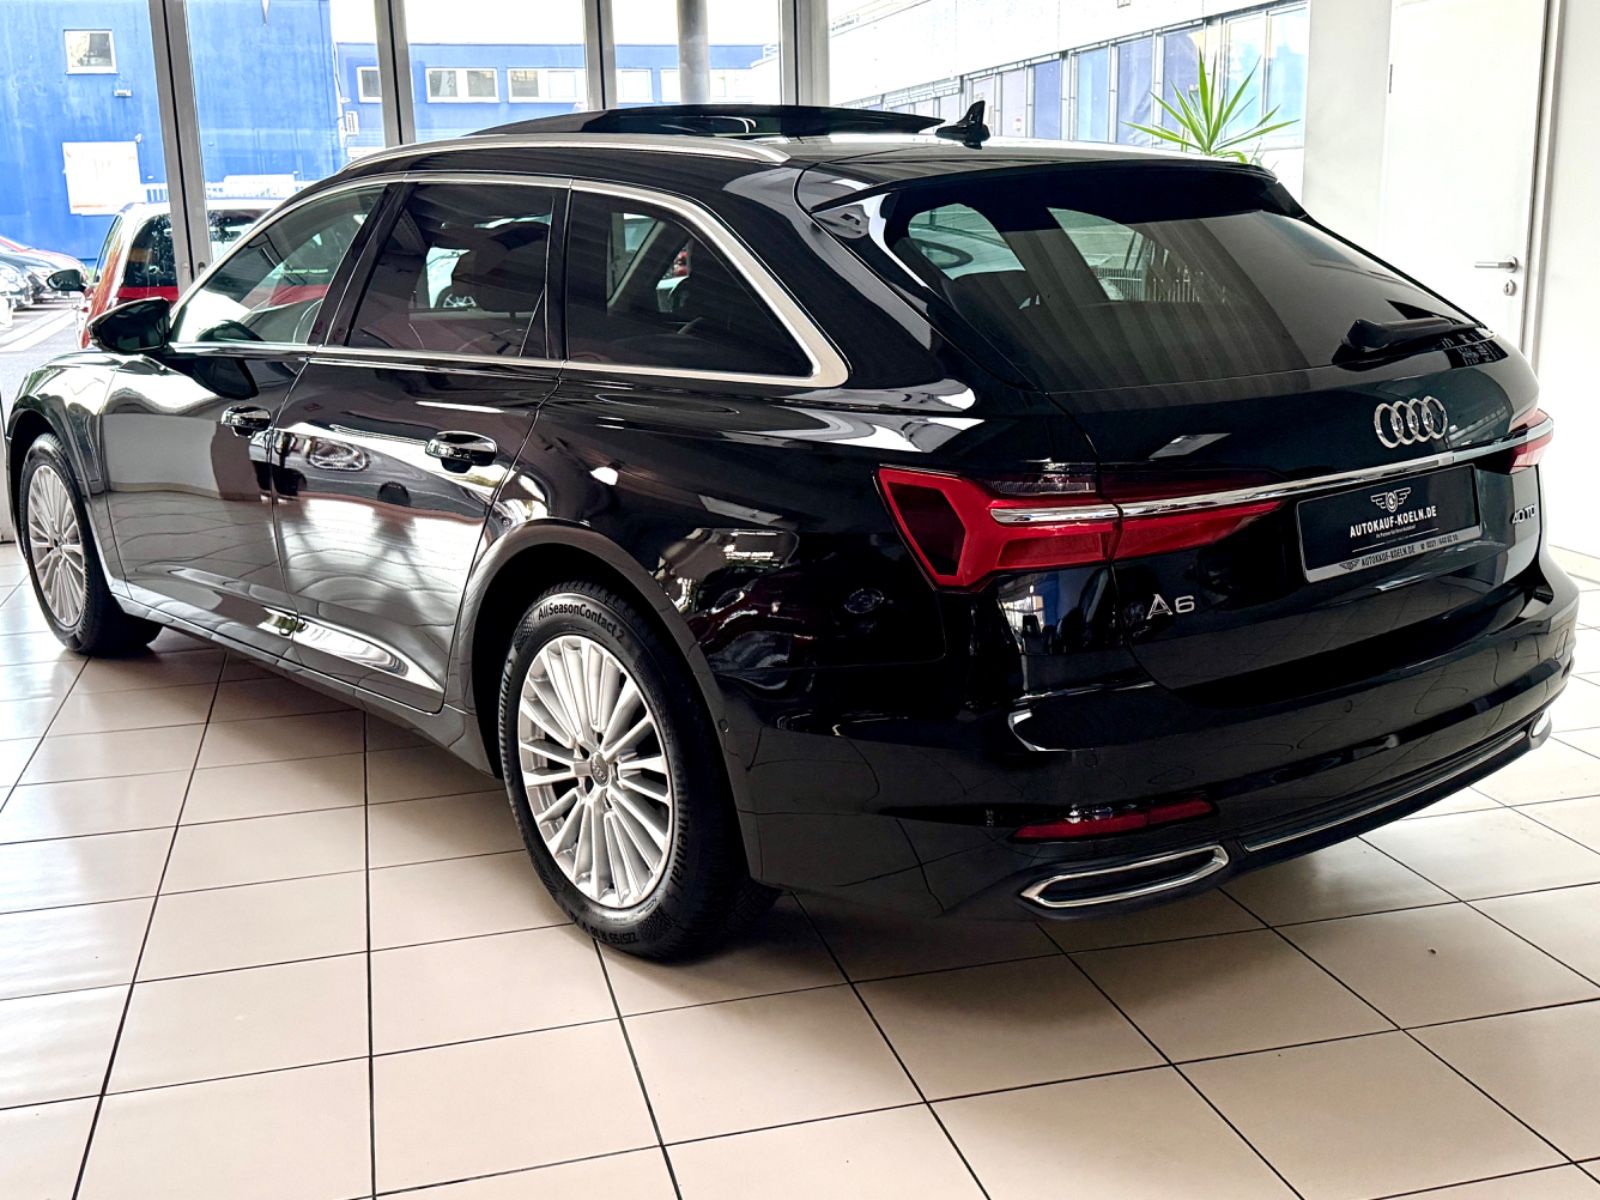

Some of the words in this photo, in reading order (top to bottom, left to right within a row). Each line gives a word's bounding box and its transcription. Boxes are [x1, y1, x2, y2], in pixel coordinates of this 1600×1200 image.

[1350, 505, 1437, 538] AUTOKAUF-KOELN.DE
[1510, 509, 1524, 524] 40
[1146, 593, 1195, 620] A6
